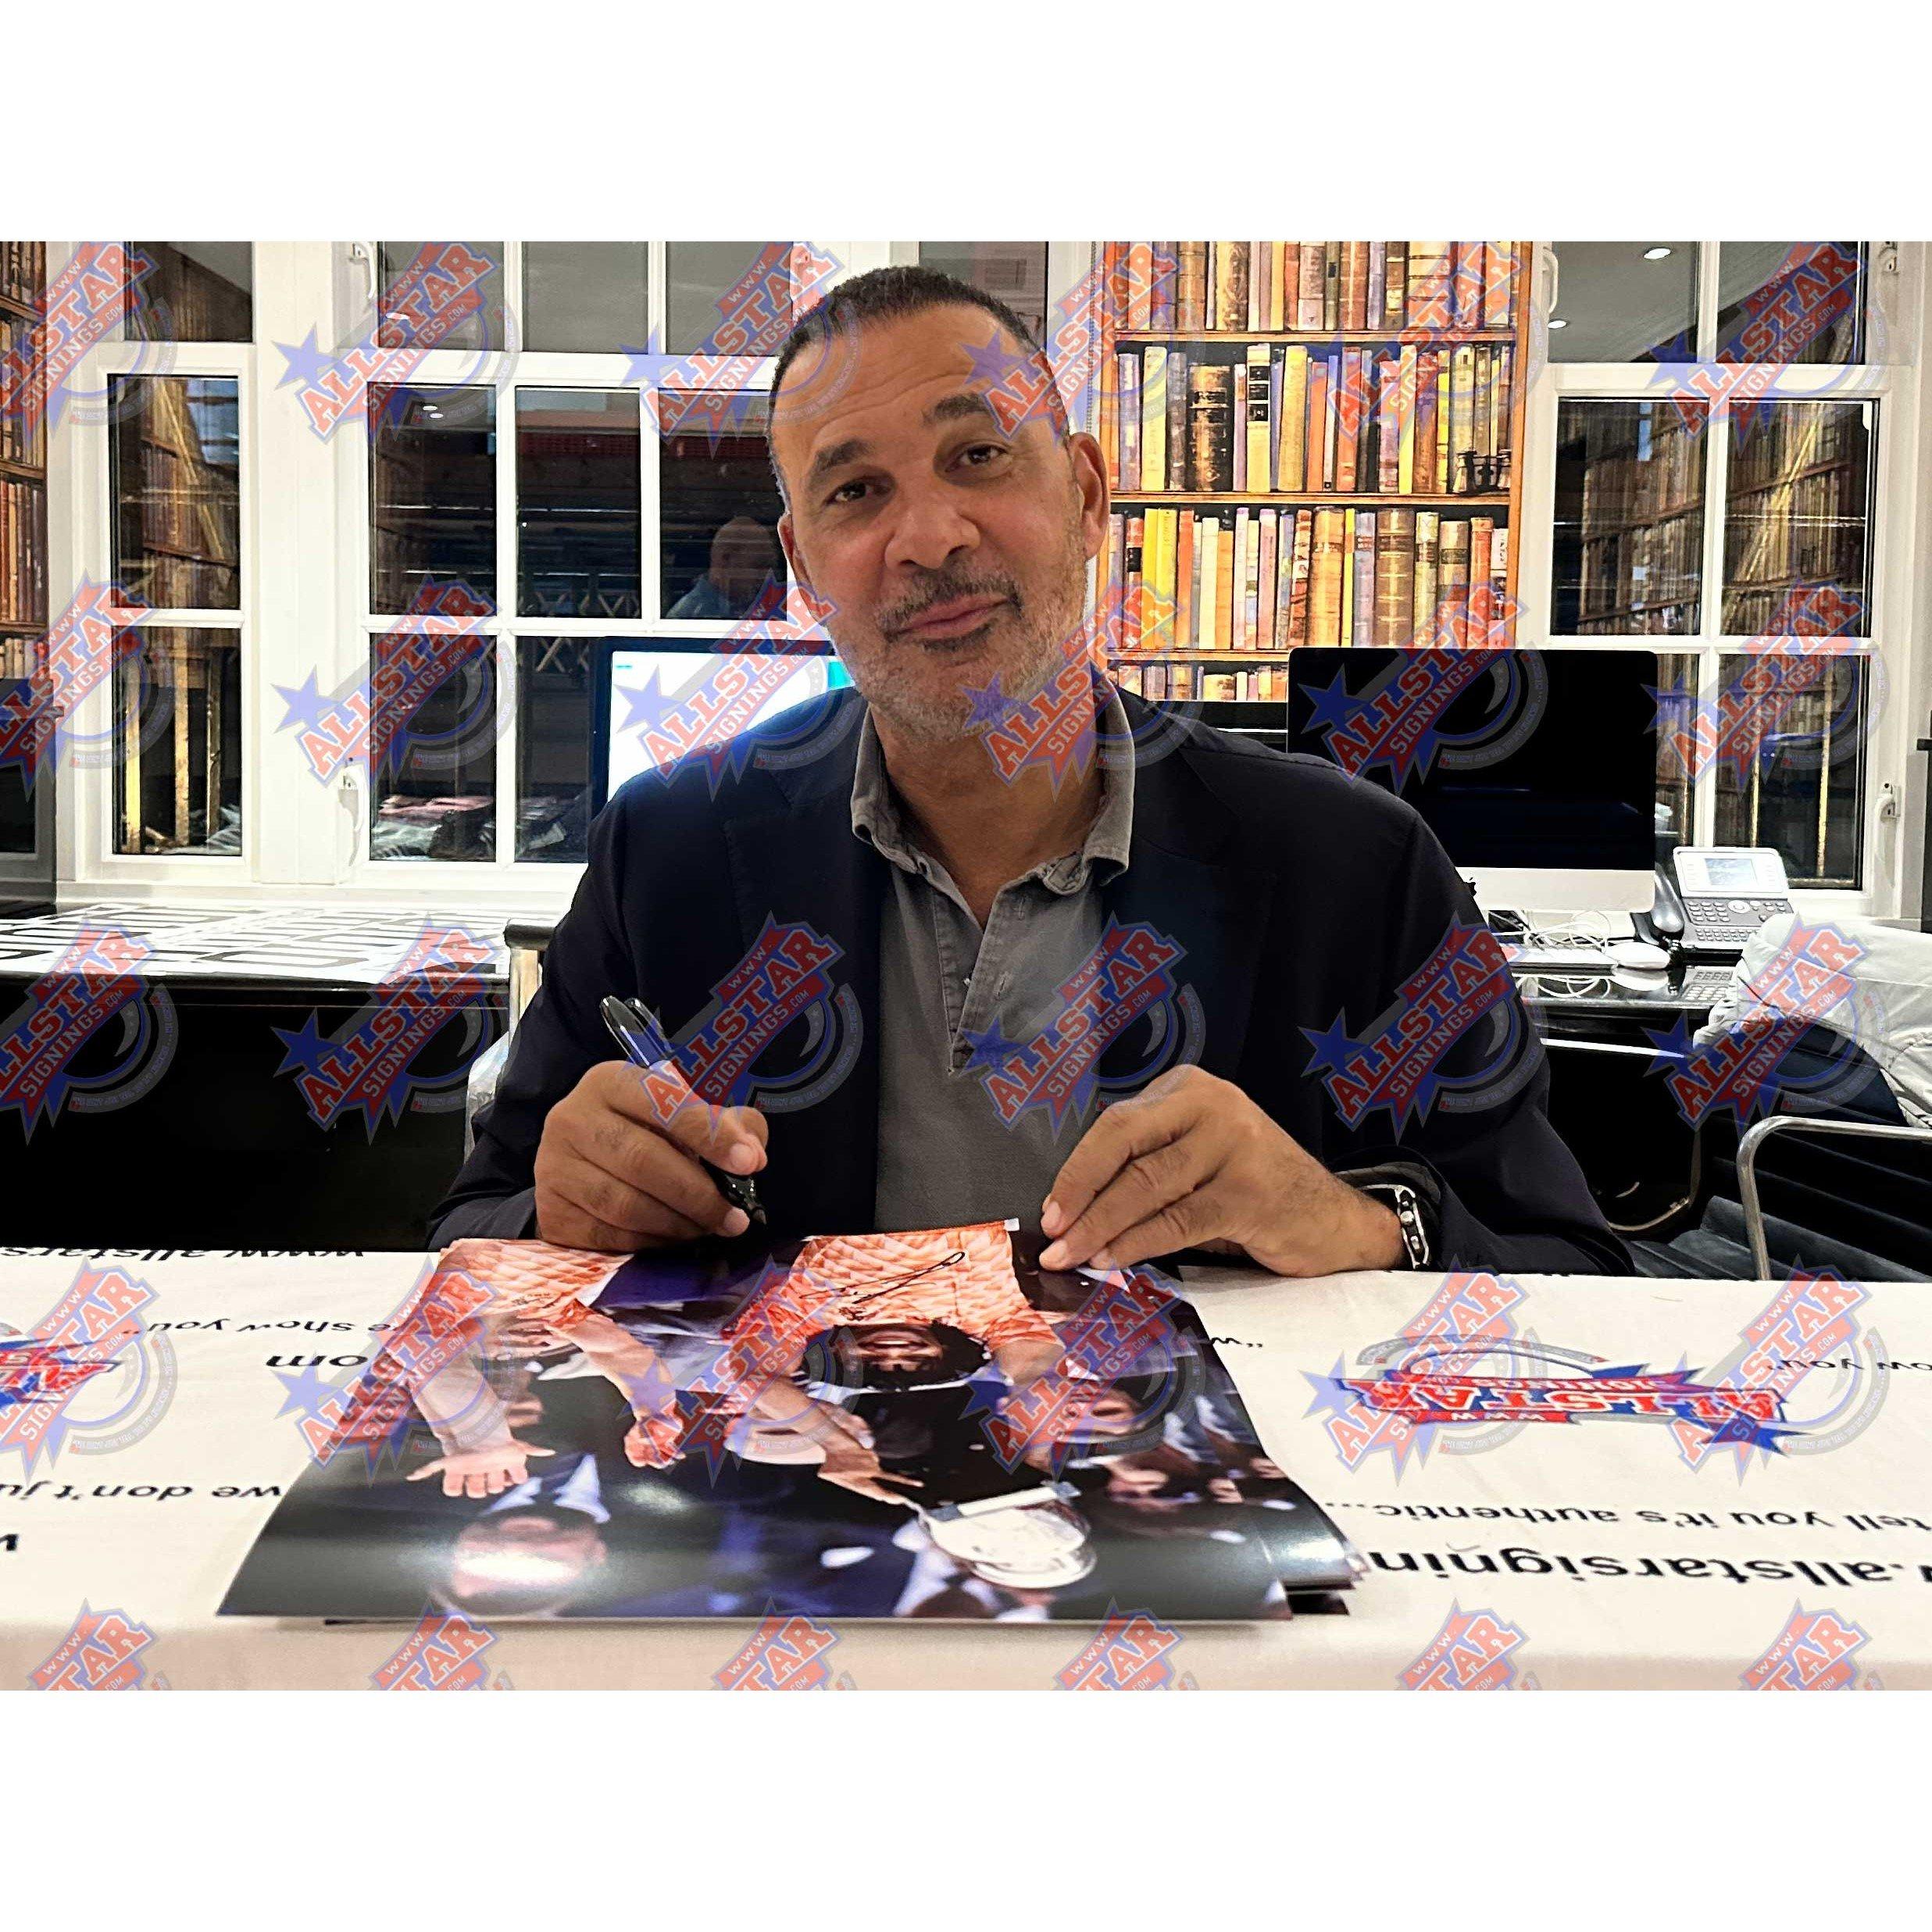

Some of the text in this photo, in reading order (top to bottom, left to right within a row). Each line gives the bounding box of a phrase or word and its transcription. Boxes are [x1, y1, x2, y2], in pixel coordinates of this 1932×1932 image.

[238, 1320, 356, 1333] show
[55, 1485, 193, 1500] don't
[212, 1486, 280, 1498] we
[1730, 1511, 1834, 1527] you
[1845, 1515, 1932, 1532] tell
